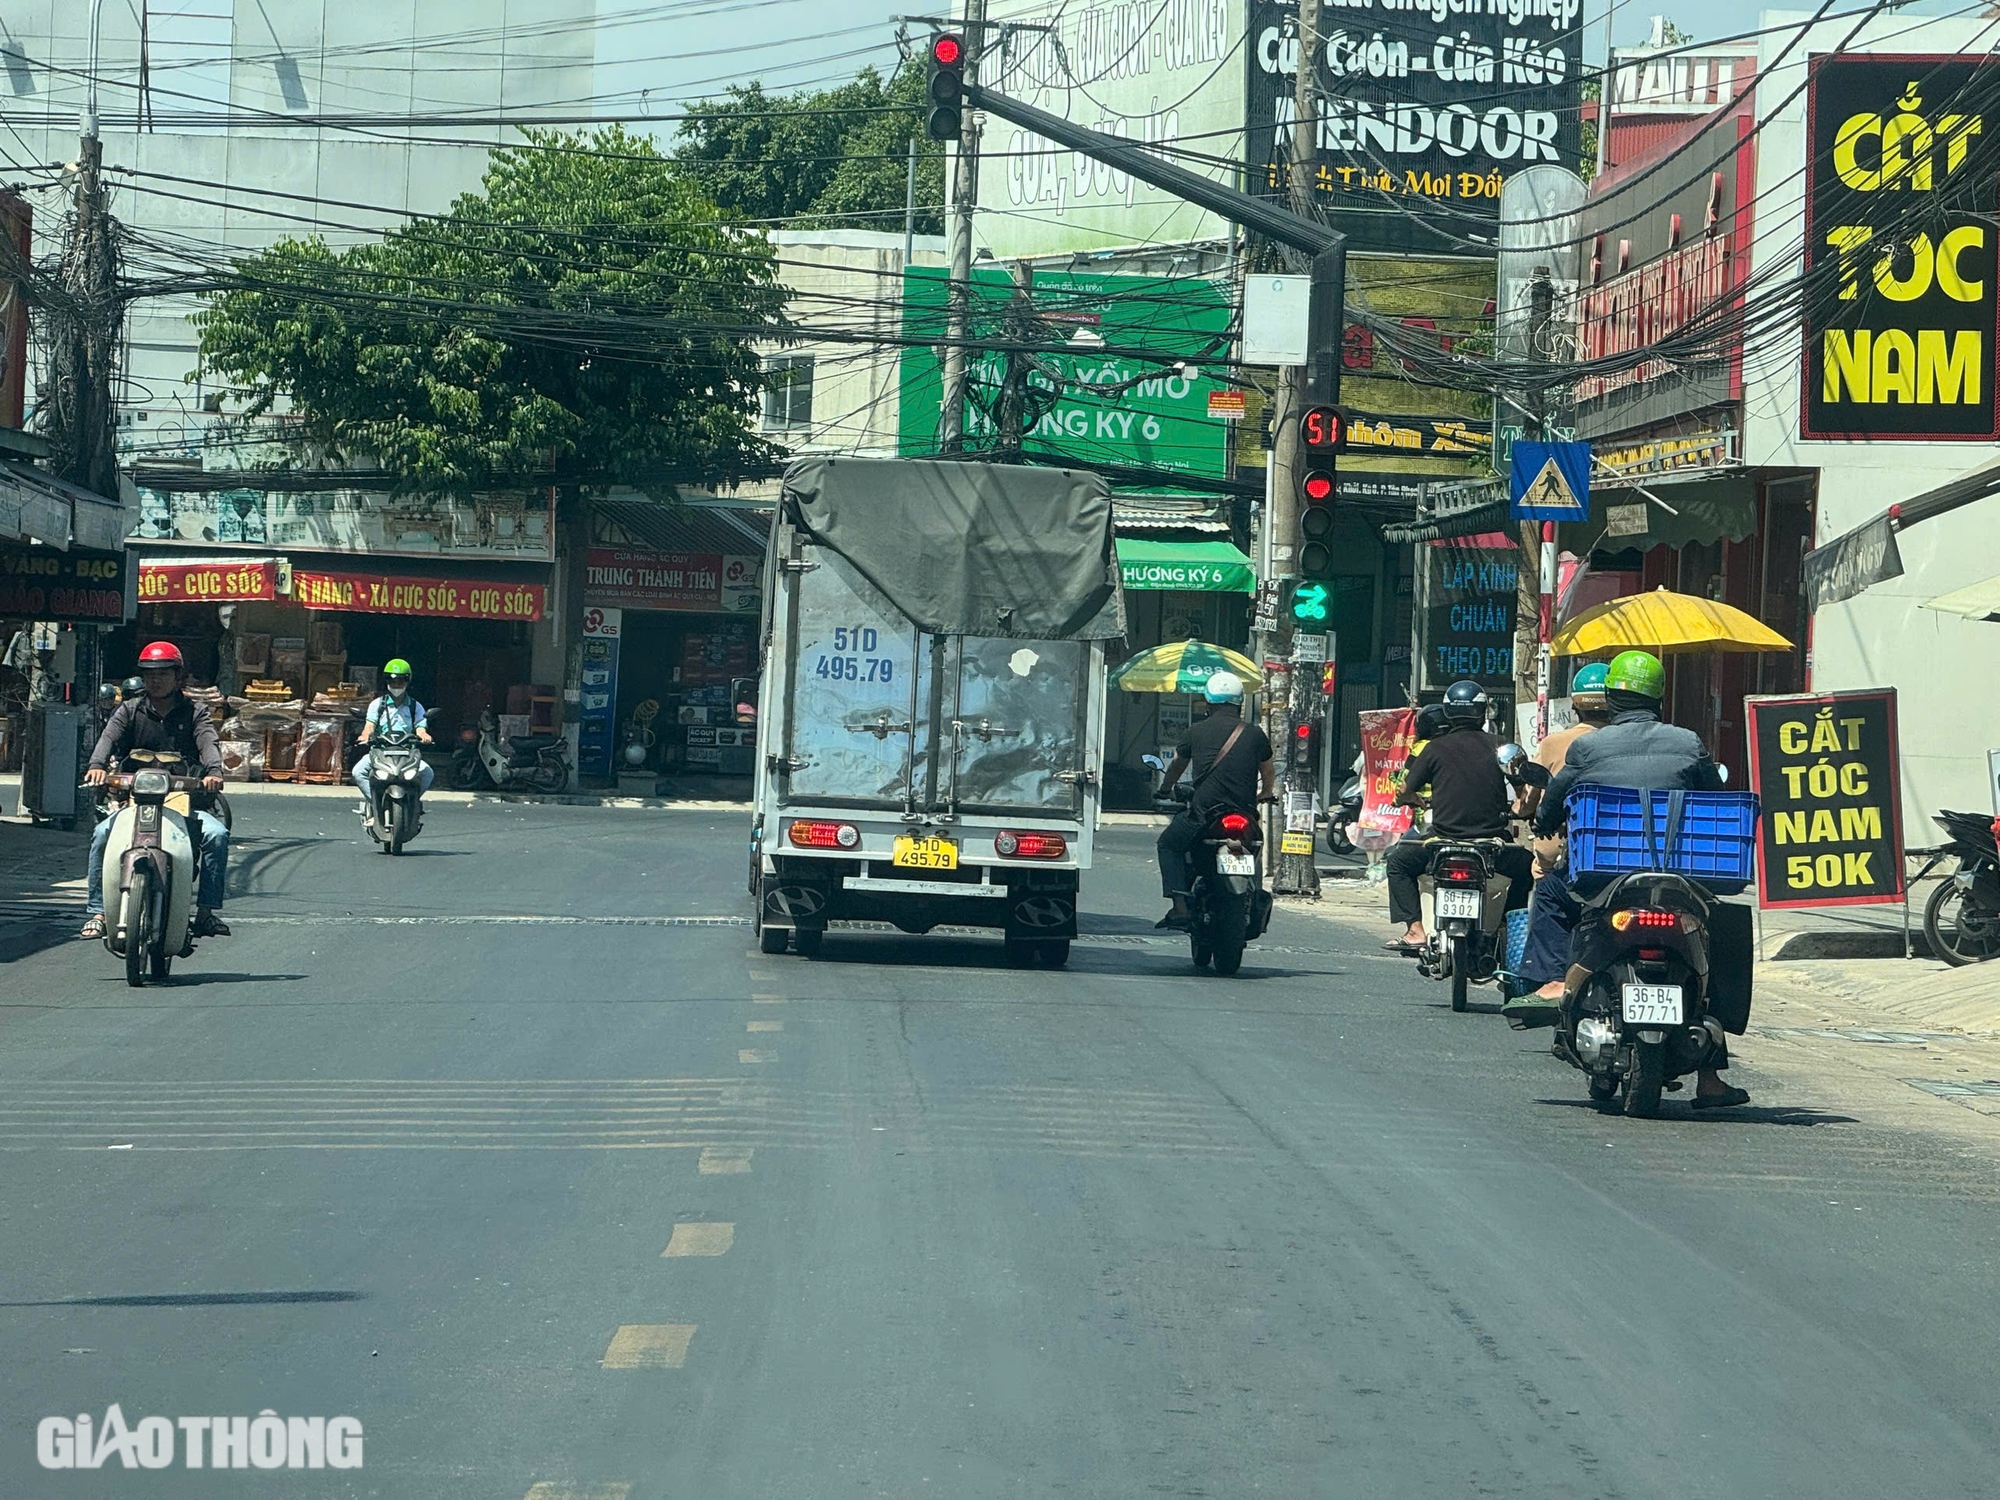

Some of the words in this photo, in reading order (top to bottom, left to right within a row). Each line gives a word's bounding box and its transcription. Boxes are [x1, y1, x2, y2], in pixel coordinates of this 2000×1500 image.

[1257, 22, 1299, 75] Cử
[1502, 36, 1566, 85] Kéo
[1834, 81, 1981, 191] CẮT
[1402, 169, 1450, 202] Mọi
[1823, 330, 1981, 404] NAM
[968, 404, 1089, 438] HNG
[1096, 404, 1137, 439] KÝ
[1142, 414, 1160, 441] 6
[1308, 412, 1338, 445] 51
[76, 559, 118, 582] BẠC
[226, 565, 262, 595] SỐC
[587, 567, 633, 586] TRUNG
[637, 565, 683, 588] THÀNH
[687, 567, 716, 590] TIẾN
[1123, 567, 1184, 581] HƯƠNG
[1188, 566, 1209, 582] KÝ
[1212, 569, 1222, 582] 6
[311, 578, 352, 605] HÀNG
[369, 577, 389, 607] XẢ
[393, 584, 423, 614] CỰC
[427, 580, 457, 611] SỐC
[470, 587, 500, 618] CỰC
[504, 585, 533, 615] SỐC
[601, 625, 618, 635] GS
[833, 626, 877, 653] 51D
[815, 656, 893, 684] 495.79
[1437, 646, 1480, 674] THEO
[1780, 708, 1866, 755] CẮT
[1780, 759, 1869, 798] TÓC
[1377, 803, 1401, 816] Mua
[1774, 806, 1882, 845] NAM
[901, 852, 951, 867] 495.79
[912, 839, 940, 852] 51D
[1220, 864, 1252, 873] 178.10
[1787, 851, 1874, 889] 50K
[1443, 904, 1473, 917] 9302
[1633, 988, 1673, 1004] 36-B4
[1628, 1004, 1677, 1021] 577.71
